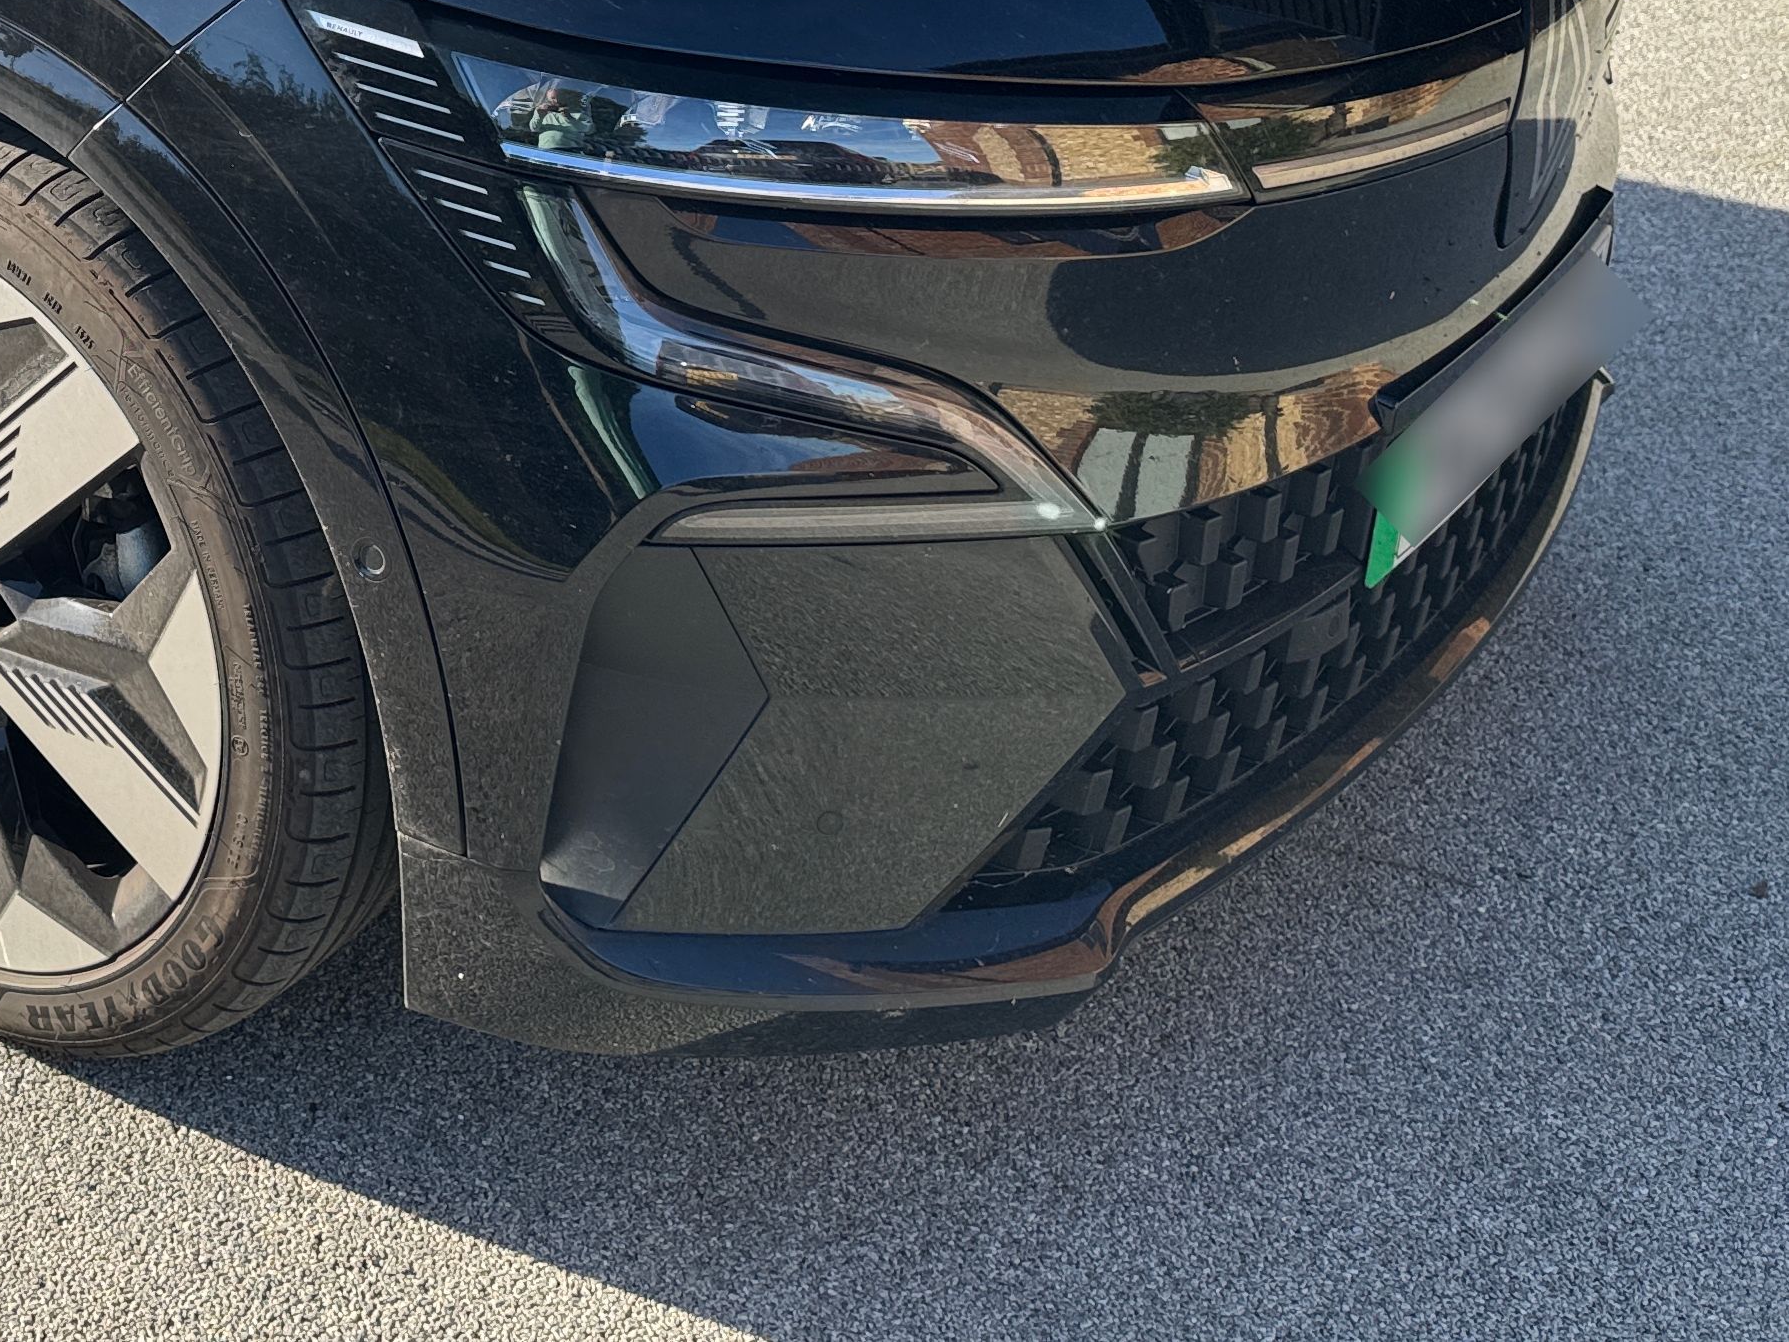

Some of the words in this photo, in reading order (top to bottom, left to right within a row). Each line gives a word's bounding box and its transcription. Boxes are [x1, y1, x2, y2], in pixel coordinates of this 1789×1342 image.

[326, 21, 363, 37] RENAULT
[127, 363, 197, 476] EfficientGrip
[26, 914, 226, 1035] GOODYEAR
